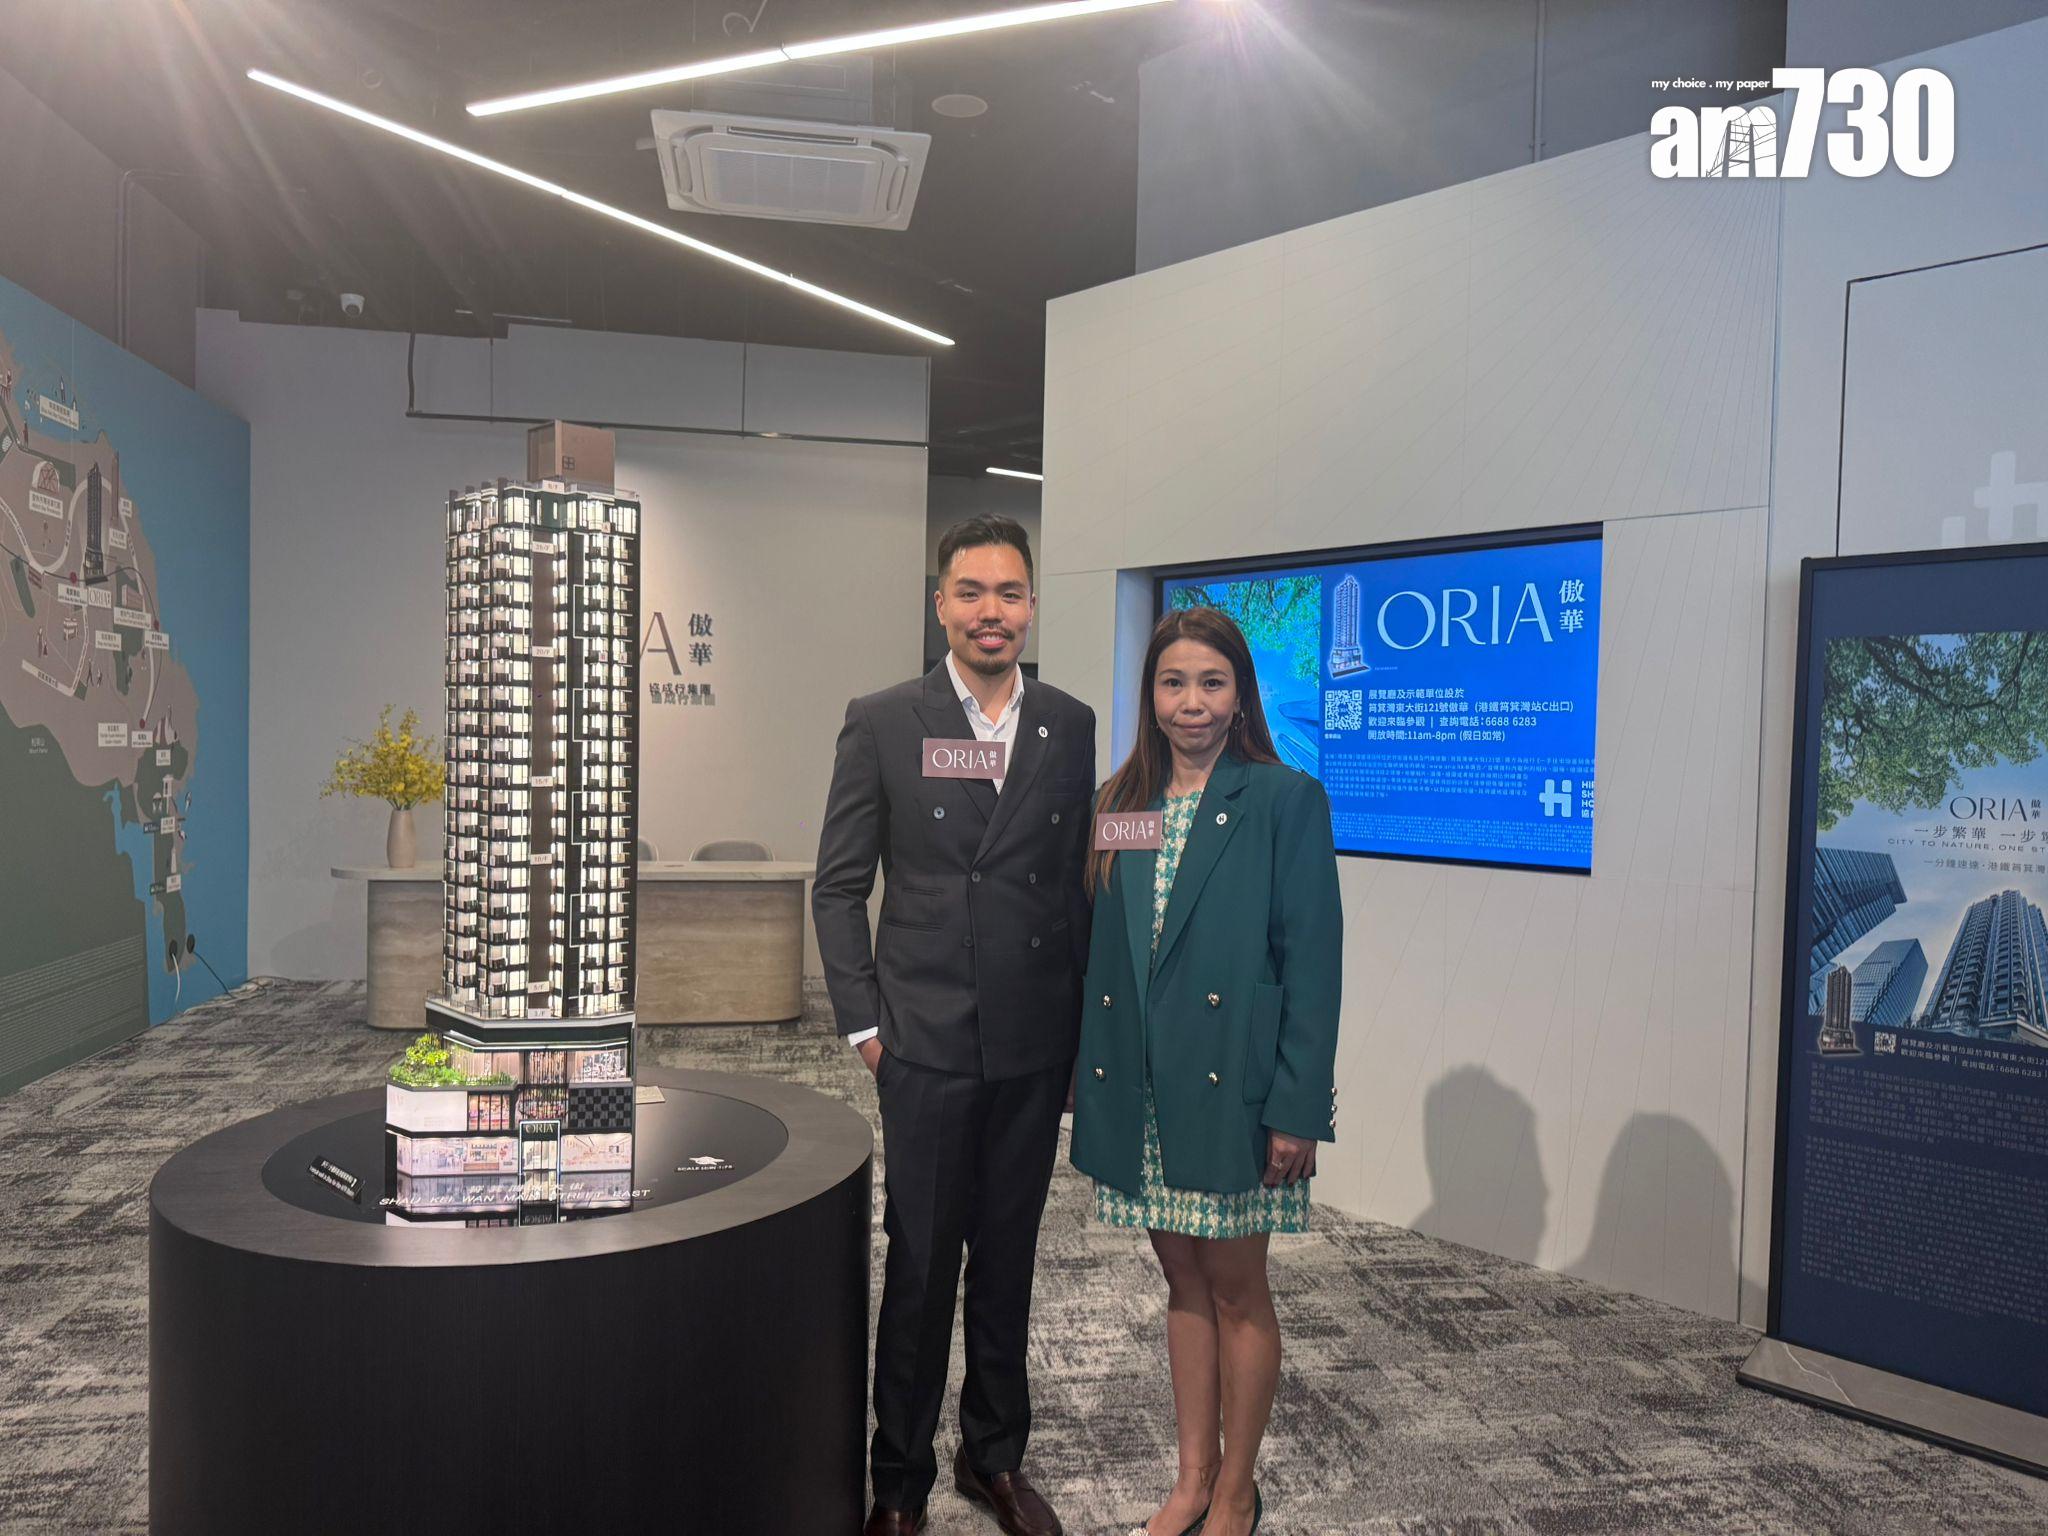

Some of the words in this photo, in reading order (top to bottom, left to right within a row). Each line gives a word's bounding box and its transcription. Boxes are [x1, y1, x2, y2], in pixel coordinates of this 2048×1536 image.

[1377, 583, 1553, 650] ORIA
[1559, 579, 1585, 633] 傲華
[688, 613, 713, 666] 傲華
[1512, 717, 1537, 727] 6283
[932, 748, 988, 769] ORIA
[1950, 796, 2027, 822] ORIA
[1102, 820, 1147, 842] ORIA
[1914, 825, 1986, 840] 一步繁華
[1888, 838, 1914, 846] CITY
[1999, 844, 2024, 852] ONE
[525, 1123, 554, 1133] ORIA
[379, 1197, 422, 1205] SHAU
[430, 1195, 453, 1203] KEI
[462, 1194, 494, 1202] WAN
[503, 1193, 539, 1202] MAIN
[612, 1189, 651, 1198] EAST
